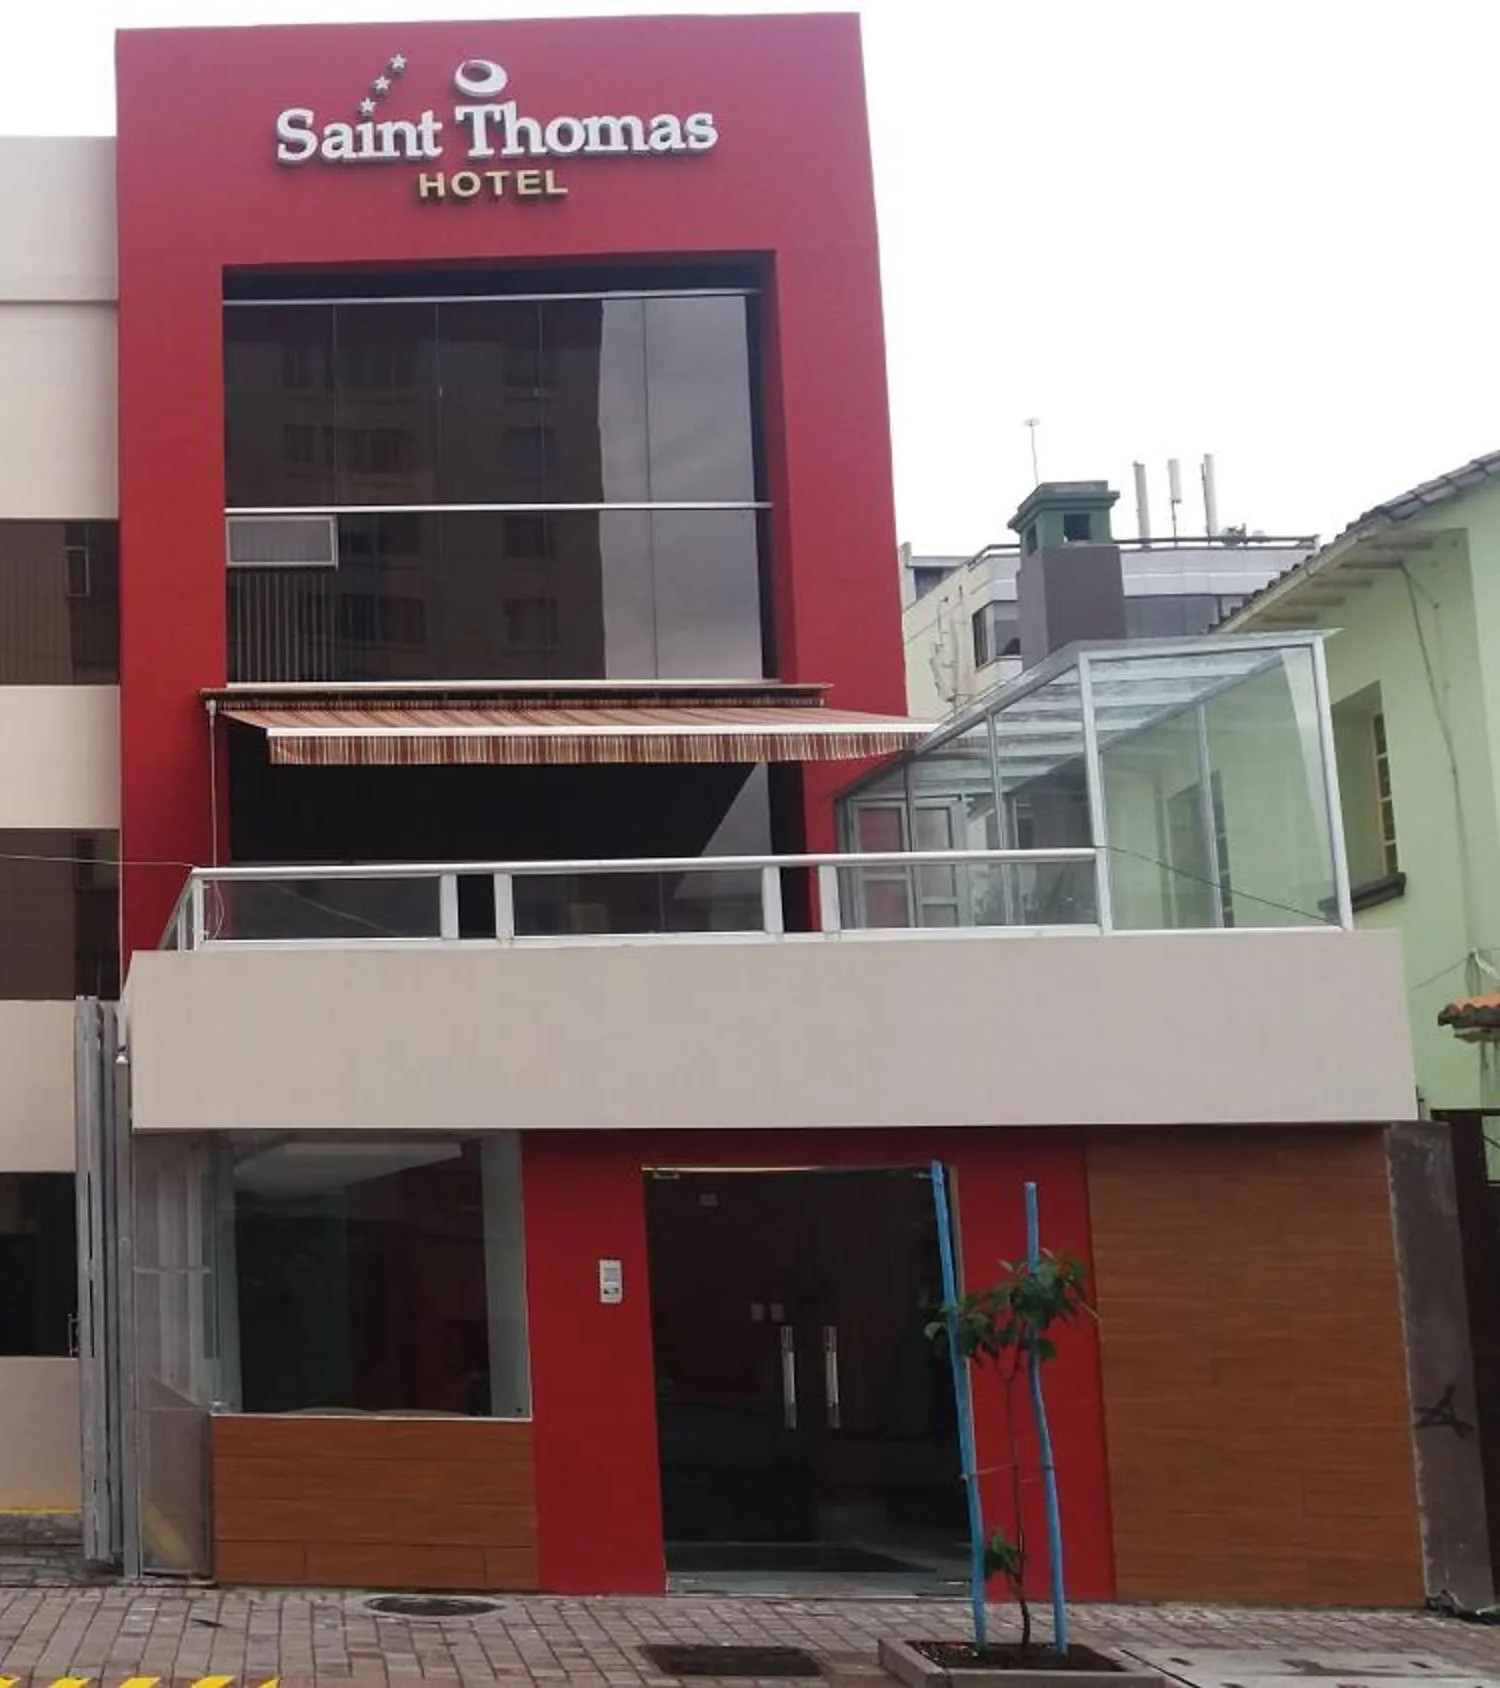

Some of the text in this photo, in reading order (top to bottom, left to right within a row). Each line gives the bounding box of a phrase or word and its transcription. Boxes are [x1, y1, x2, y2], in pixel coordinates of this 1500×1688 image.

[276, 100, 720, 163] Saint Thomas
[418, 168, 570, 198] HOTEL
